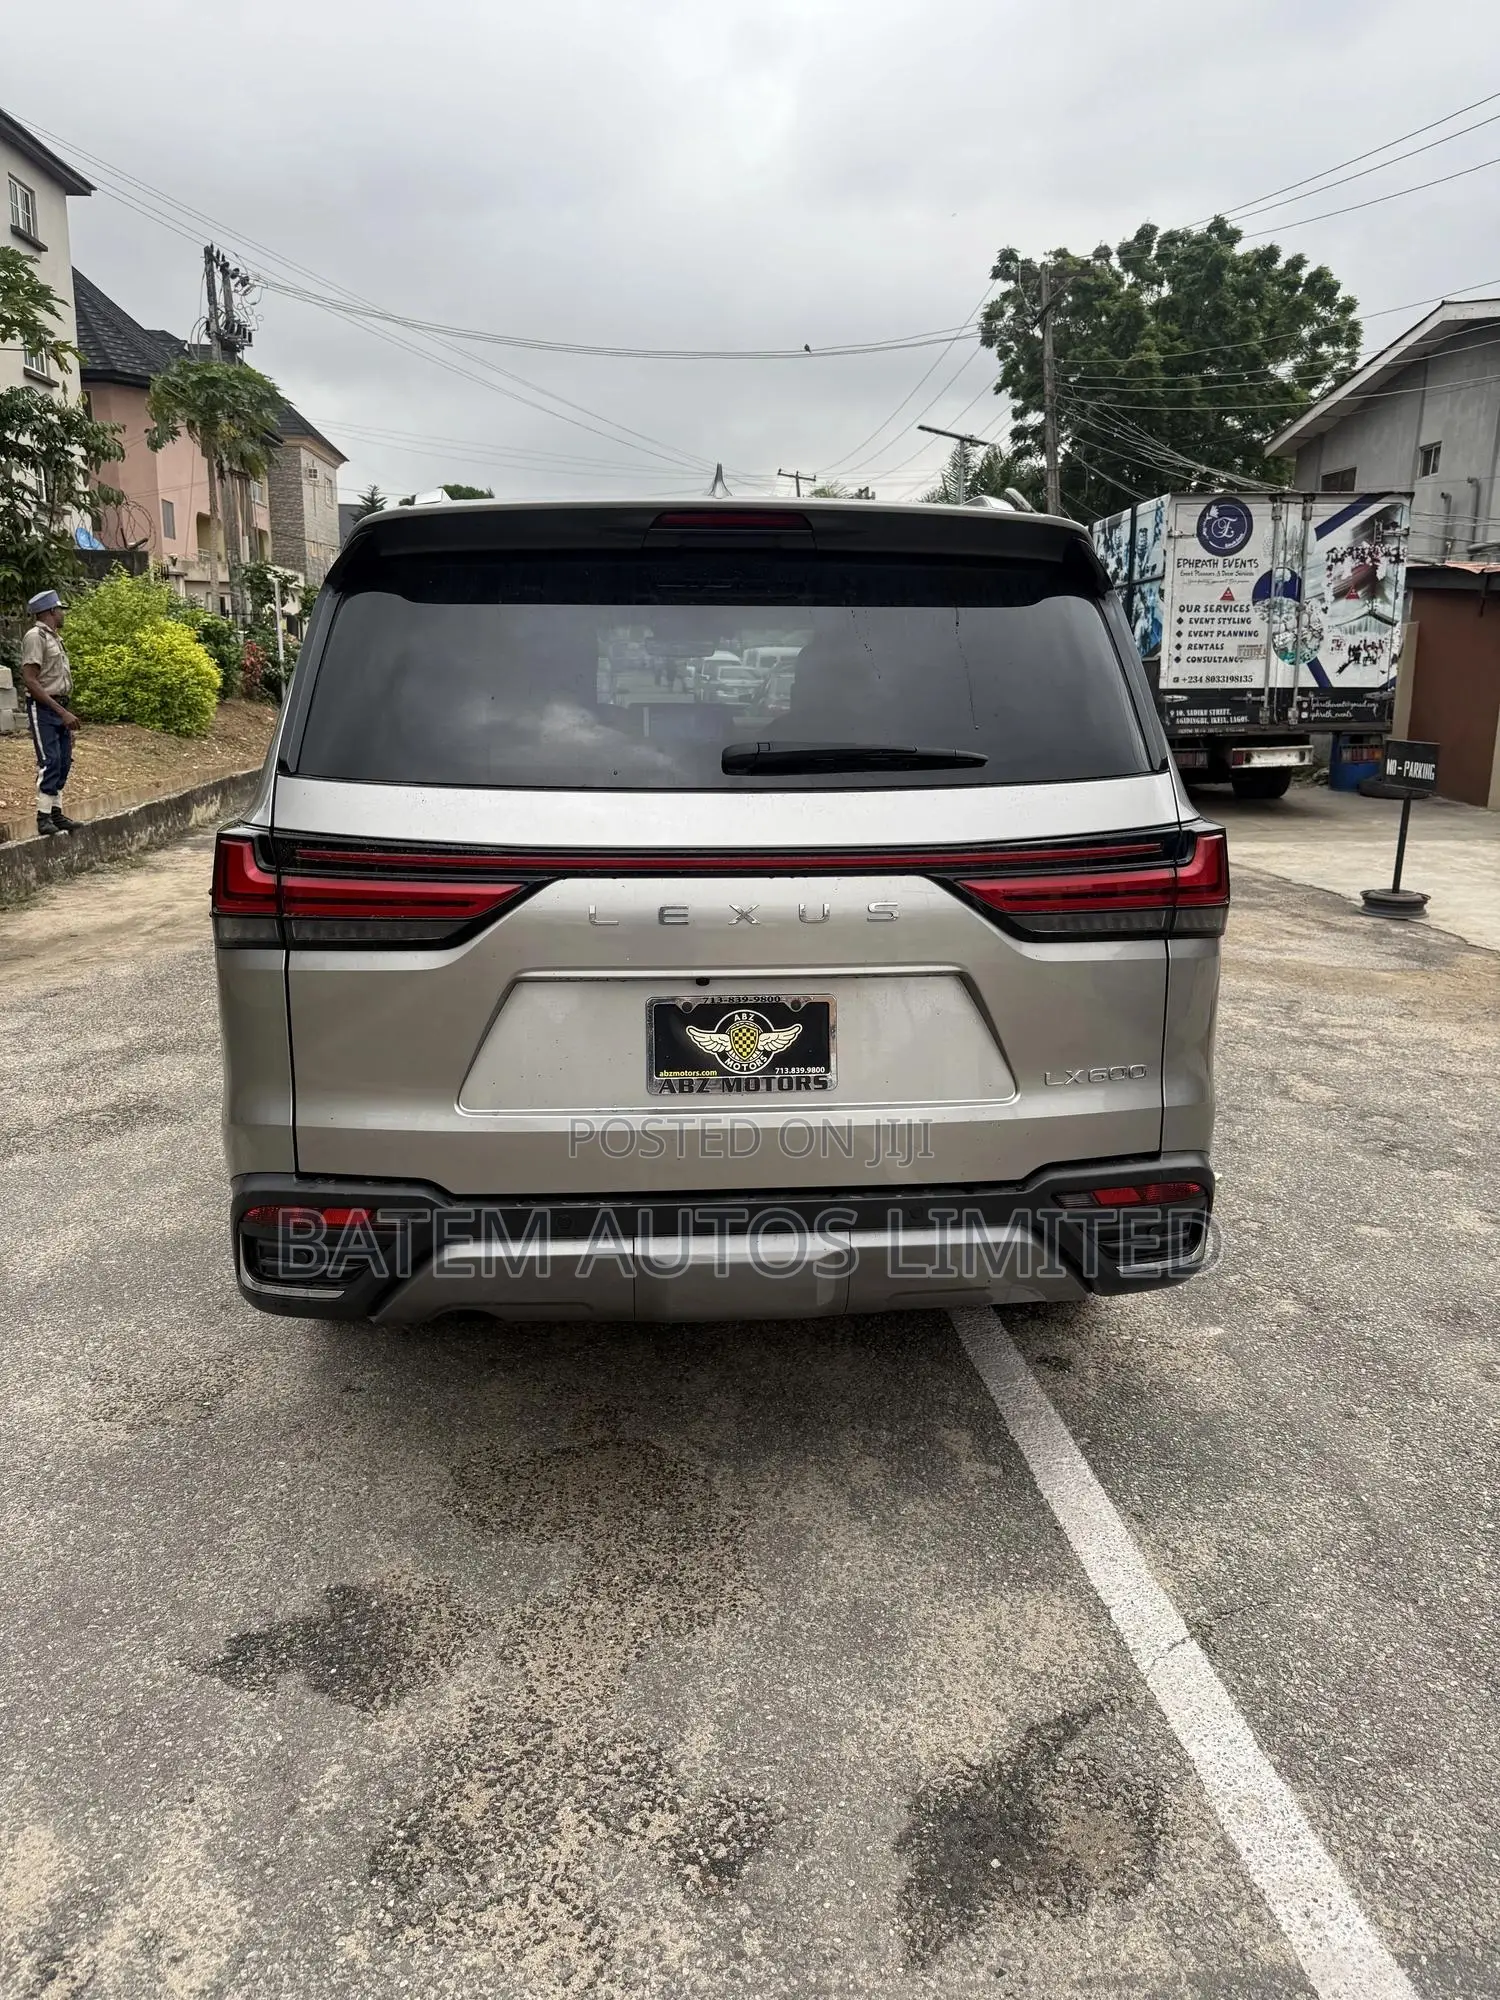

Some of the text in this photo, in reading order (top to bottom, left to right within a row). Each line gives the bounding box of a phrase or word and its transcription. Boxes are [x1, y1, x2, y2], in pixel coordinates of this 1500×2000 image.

[1176, 558, 1260, 569] EPHRATH EVENTS
[1178, 604, 1251, 613] OUR SERVICES
[1188, 617, 1252, 625] EVENT STYLING
[1187, 630, 1259, 638] EVENT PLANNING
[1186, 643, 1225, 651] RENTALS
[1181, 674, 1254, 684] +234 8033198135
[1386, 758, 1397, 776] NO
[1403, 760, 1436, 780] PARKING
[587, 901, 901, 926] LEXUS
[702, 995, 782, 1004] 713-839-9800
[733, 1013, 755, 1022] ABZ
[724, 1055, 768, 1071] MOTORS
[659, 1069, 718, 1077] abzmotors.com
[775, 1066, 826, 1075] 713.839.9800
[1044, 1064, 1147, 1086] LX600
[658, 1075, 829, 1094] ABZ MOTORS
